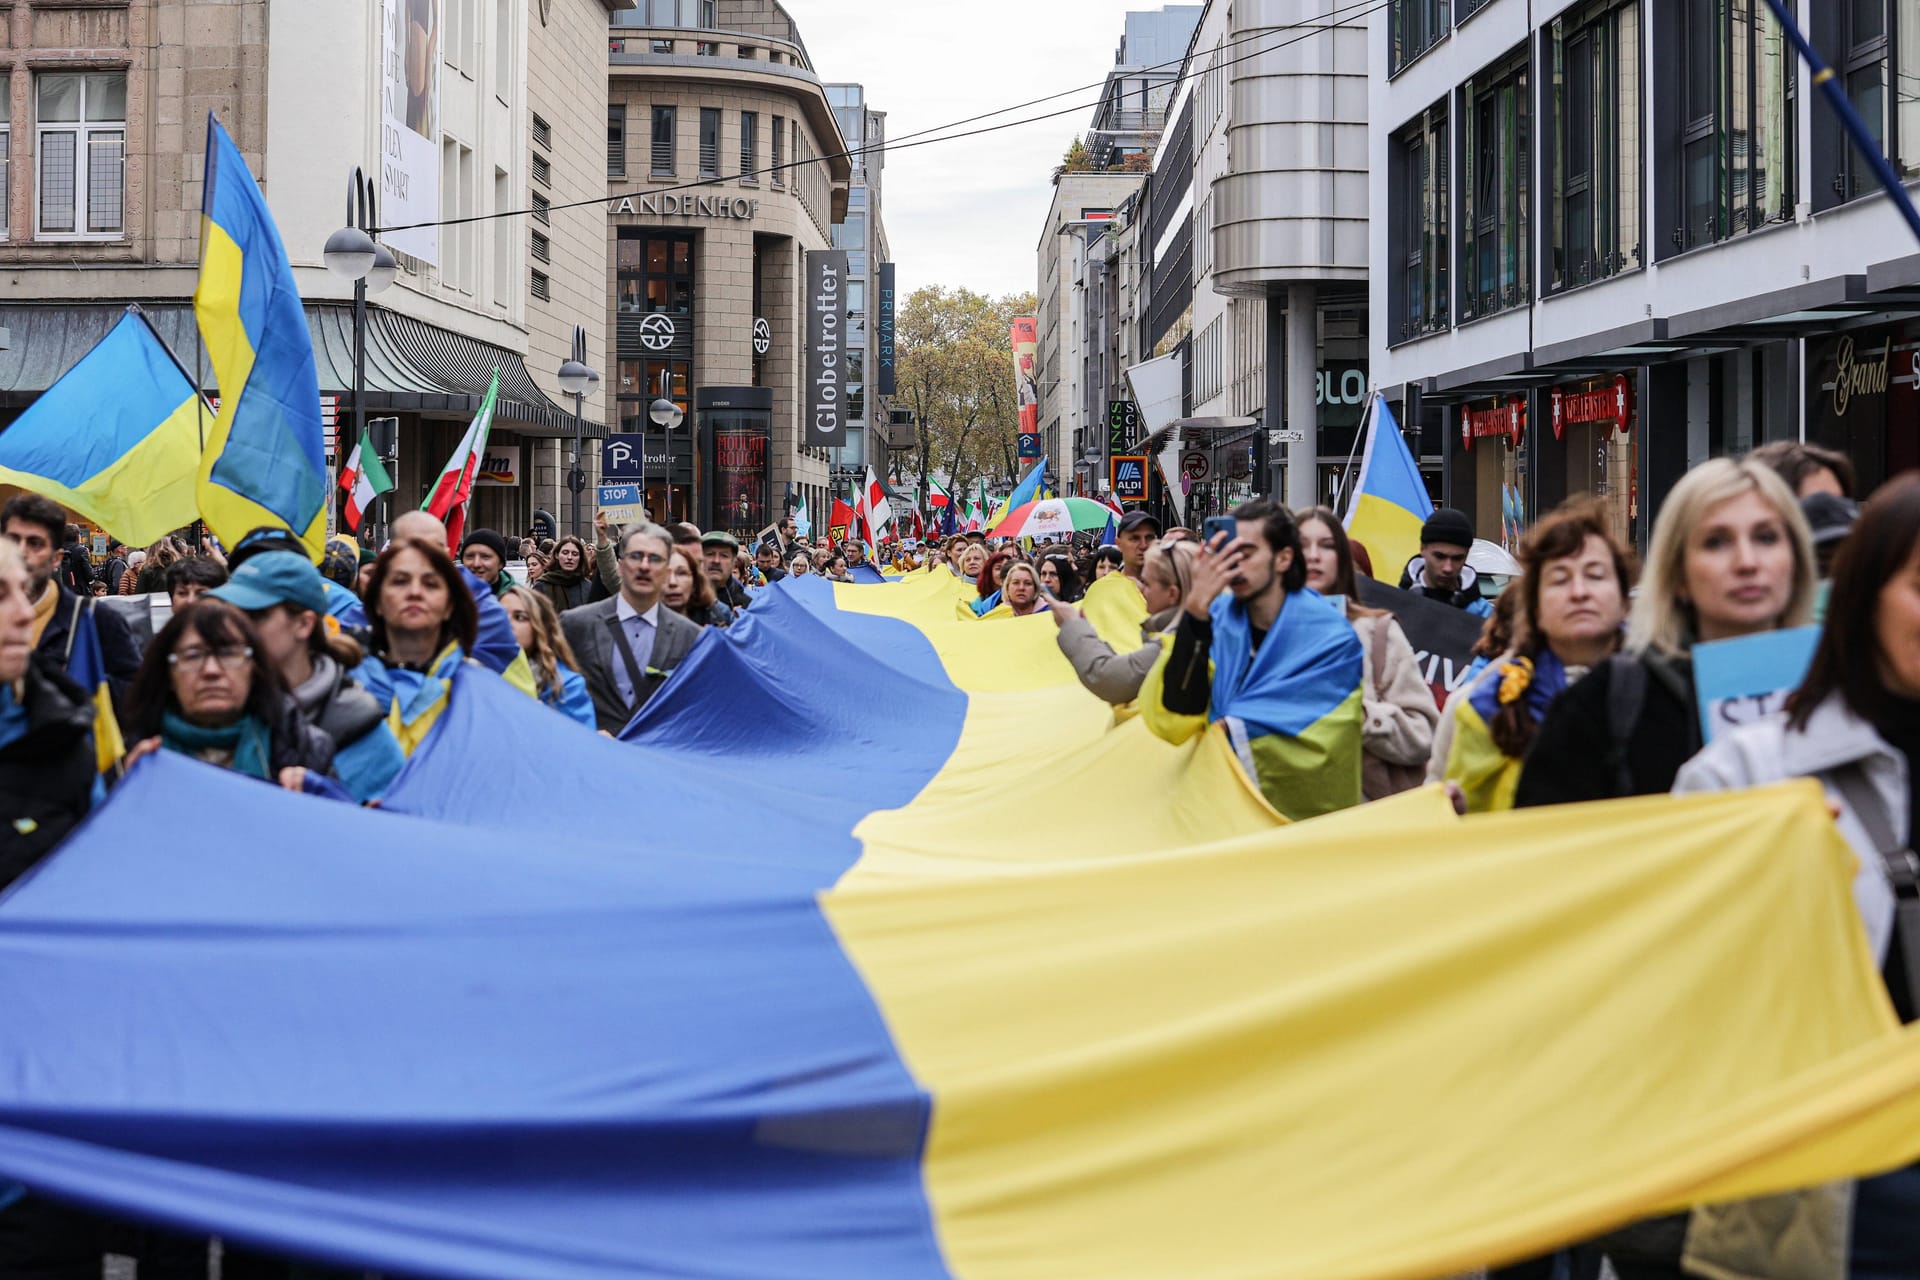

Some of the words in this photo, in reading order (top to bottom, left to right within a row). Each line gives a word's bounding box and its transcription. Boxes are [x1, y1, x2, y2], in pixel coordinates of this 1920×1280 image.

[384, 162, 410, 201] SMART
[880, 289, 893, 368] PRIMARK
[816, 264, 838, 433] Globetrotter
[1834, 336, 1889, 416] Grand
[717, 436, 759, 450] MOULIN
[612, 448, 630, 469] P
[604, 489, 627, 499] STOP
[1118, 481, 1141, 489] ALDI
